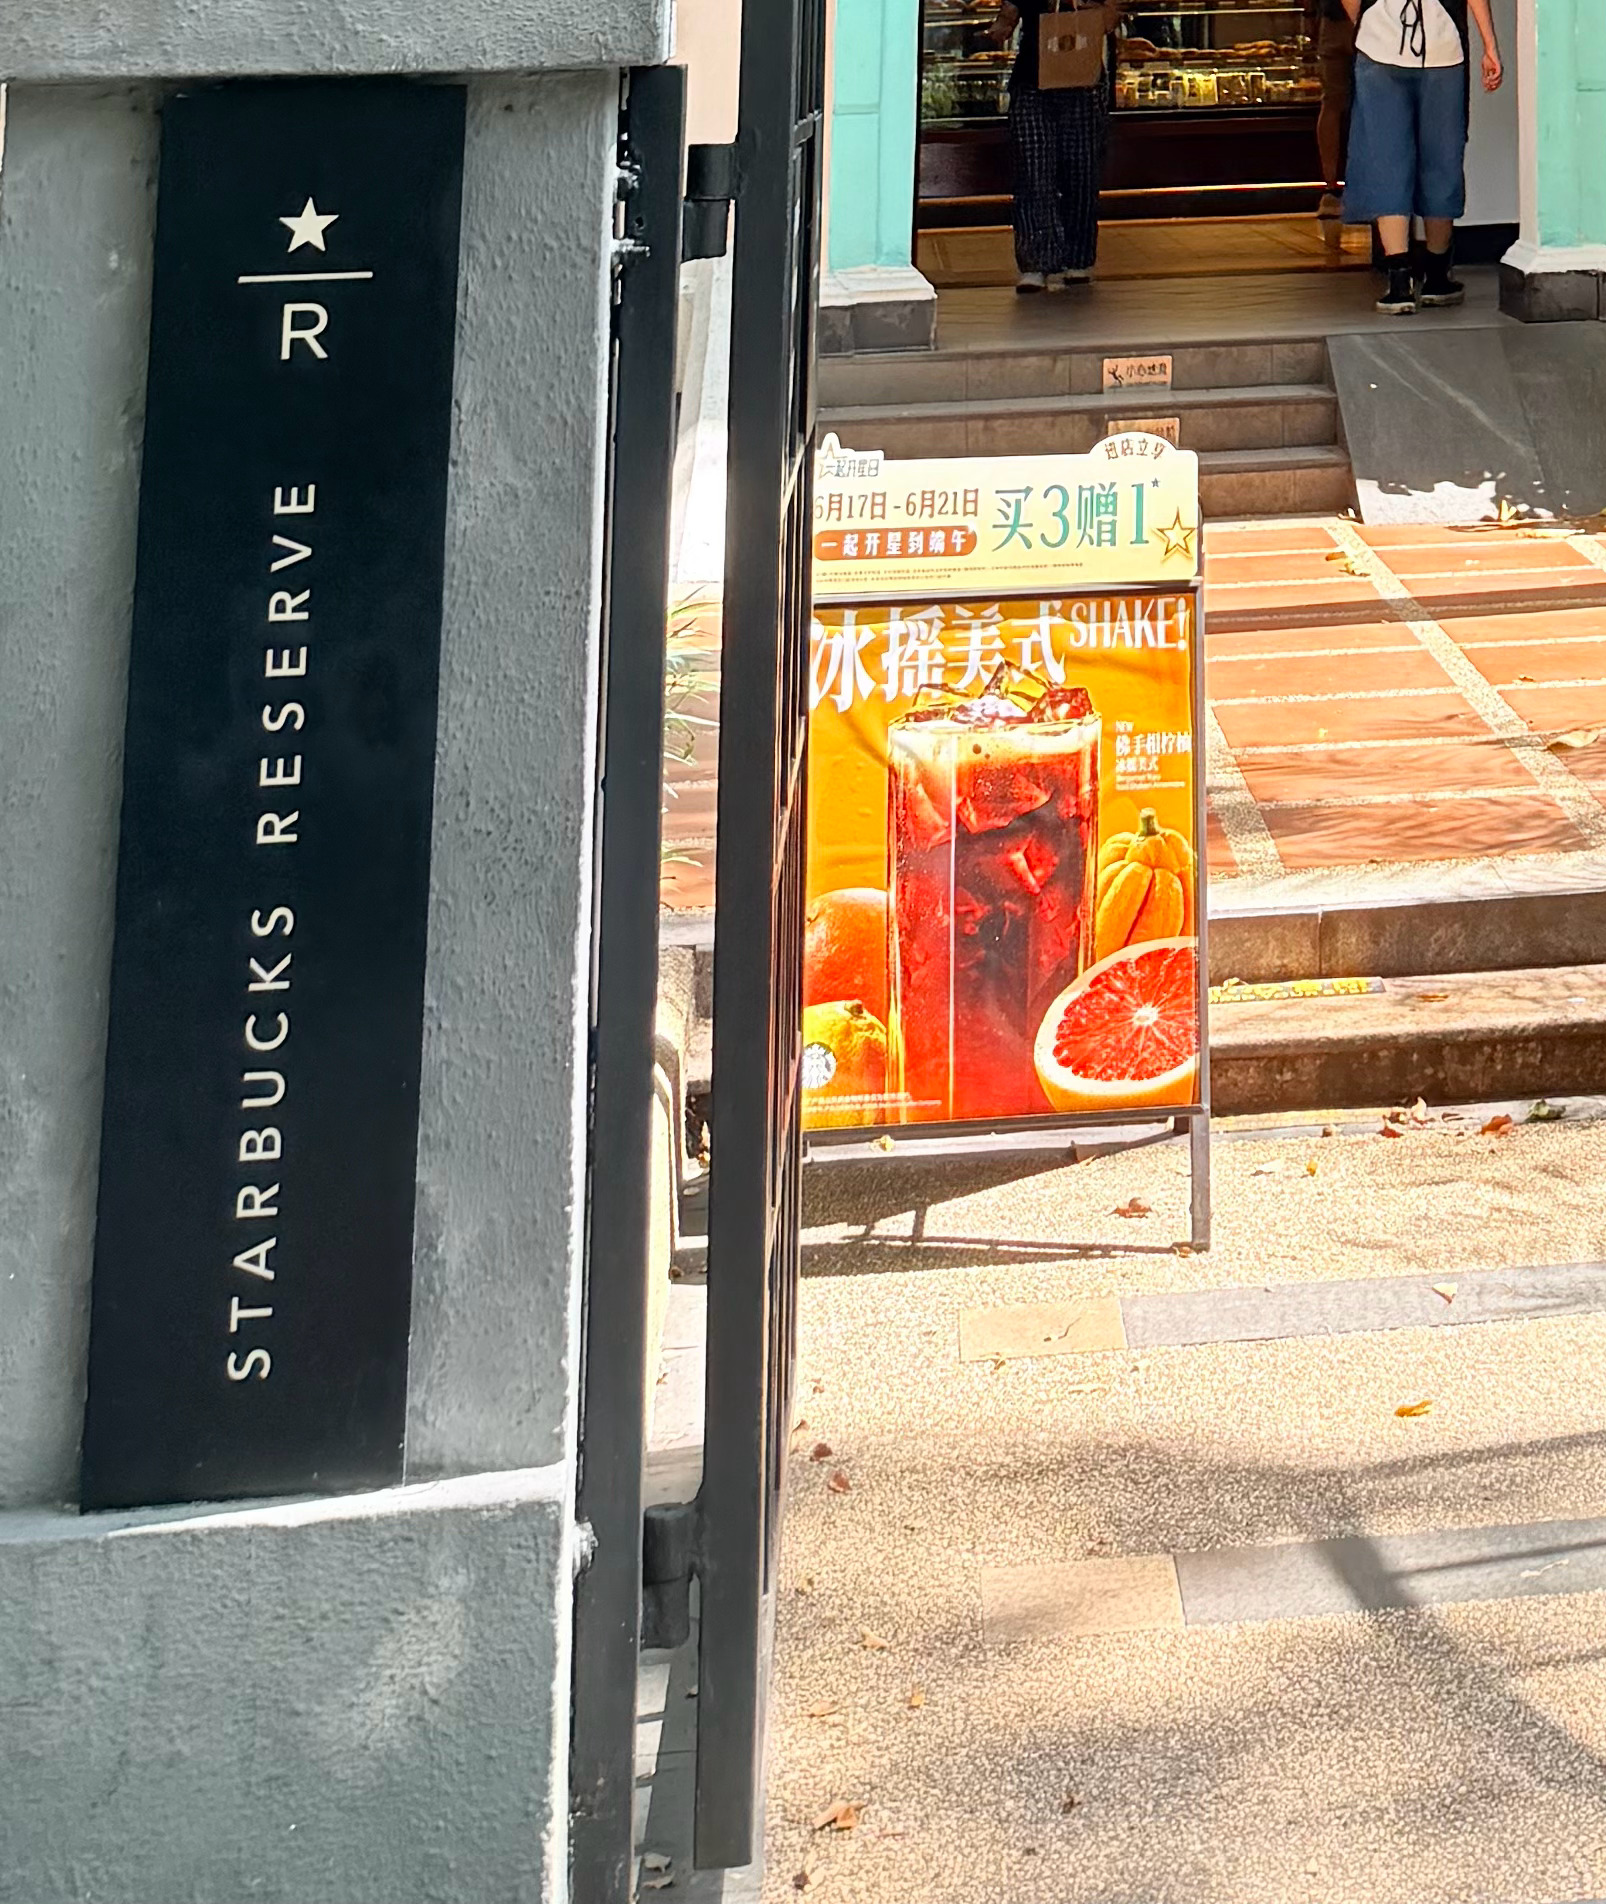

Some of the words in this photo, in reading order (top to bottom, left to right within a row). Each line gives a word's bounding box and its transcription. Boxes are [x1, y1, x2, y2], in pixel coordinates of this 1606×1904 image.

[280, 301, 329, 361] R
[256, 480, 317, 848] RESERVE
[810, 600, 1067, 713] 冰摇美式
[1069, 597, 1188, 651] SHAKE!
[226, 904, 296, 1384] STARBUCKS
